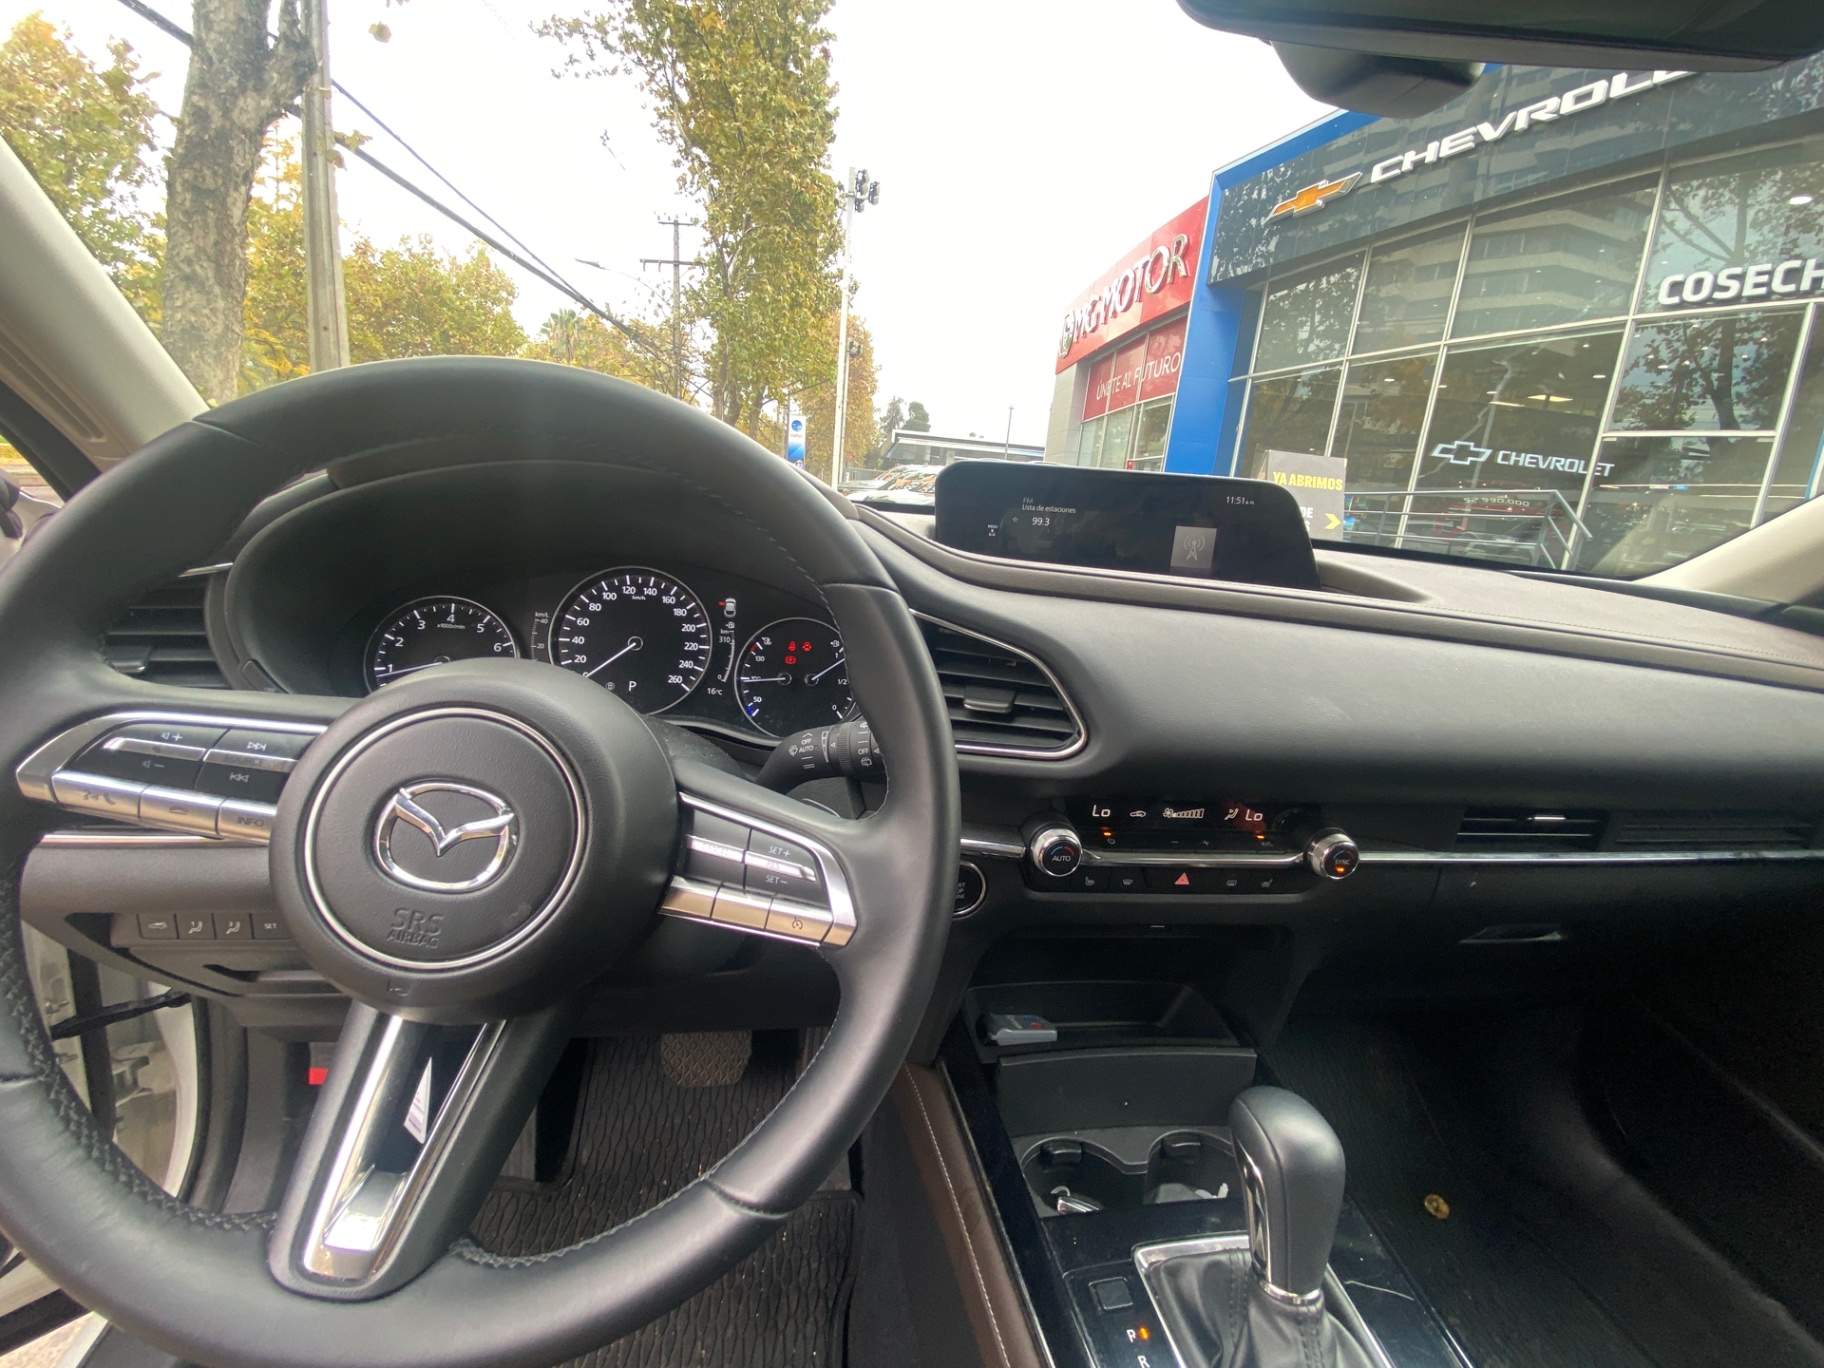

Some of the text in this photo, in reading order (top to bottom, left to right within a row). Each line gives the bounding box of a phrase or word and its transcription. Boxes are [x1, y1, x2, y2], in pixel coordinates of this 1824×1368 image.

[1121, 371, 1132, 390] AL
[1133, 351, 1182, 387] FUTURO
[1496, 450, 1615, 477] CHEVROLET
[1273, 471, 1343, 491] YA ABRIMOS
[1045, 505, 1077, 514] estaciones
[1031, 516, 1050, 527] 99.3
[622, 585, 637, 595] 120
[643, 587, 658, 596] 140
[602, 591, 618, 601] 100
[661, 595, 677, 605] 160
[588, 602, 602, 612] 80
[672, 607, 688, 617] 180
[445, 613, 456, 624] 4
[576, 617, 590, 627] 60
[416, 619, 427, 631] 3
[475, 623, 486, 634] 5
[681, 622, 697, 633] 200
[394, 636, 405, 648] 2
[571, 635, 585, 645] 40
[493, 642, 503, 653] 6
[684, 641, 700, 651] 220
[574, 654, 588, 664] 20
[387, 663, 394, 673] 1
[678, 659, 695, 670] 240
[667, 674, 684, 684] 260
[837, 677, 849, 686] 1/2
[628, 680, 638, 692] P
[799, 744, 815, 753] AUTO
[237, 816, 266, 828] INFO
[1051, 855, 1071, 863] AUTO
[391, 907, 446, 936] SRS
[387, 929, 441, 950] AIRBAG
[1136, 1354, 1151, 1368] R
